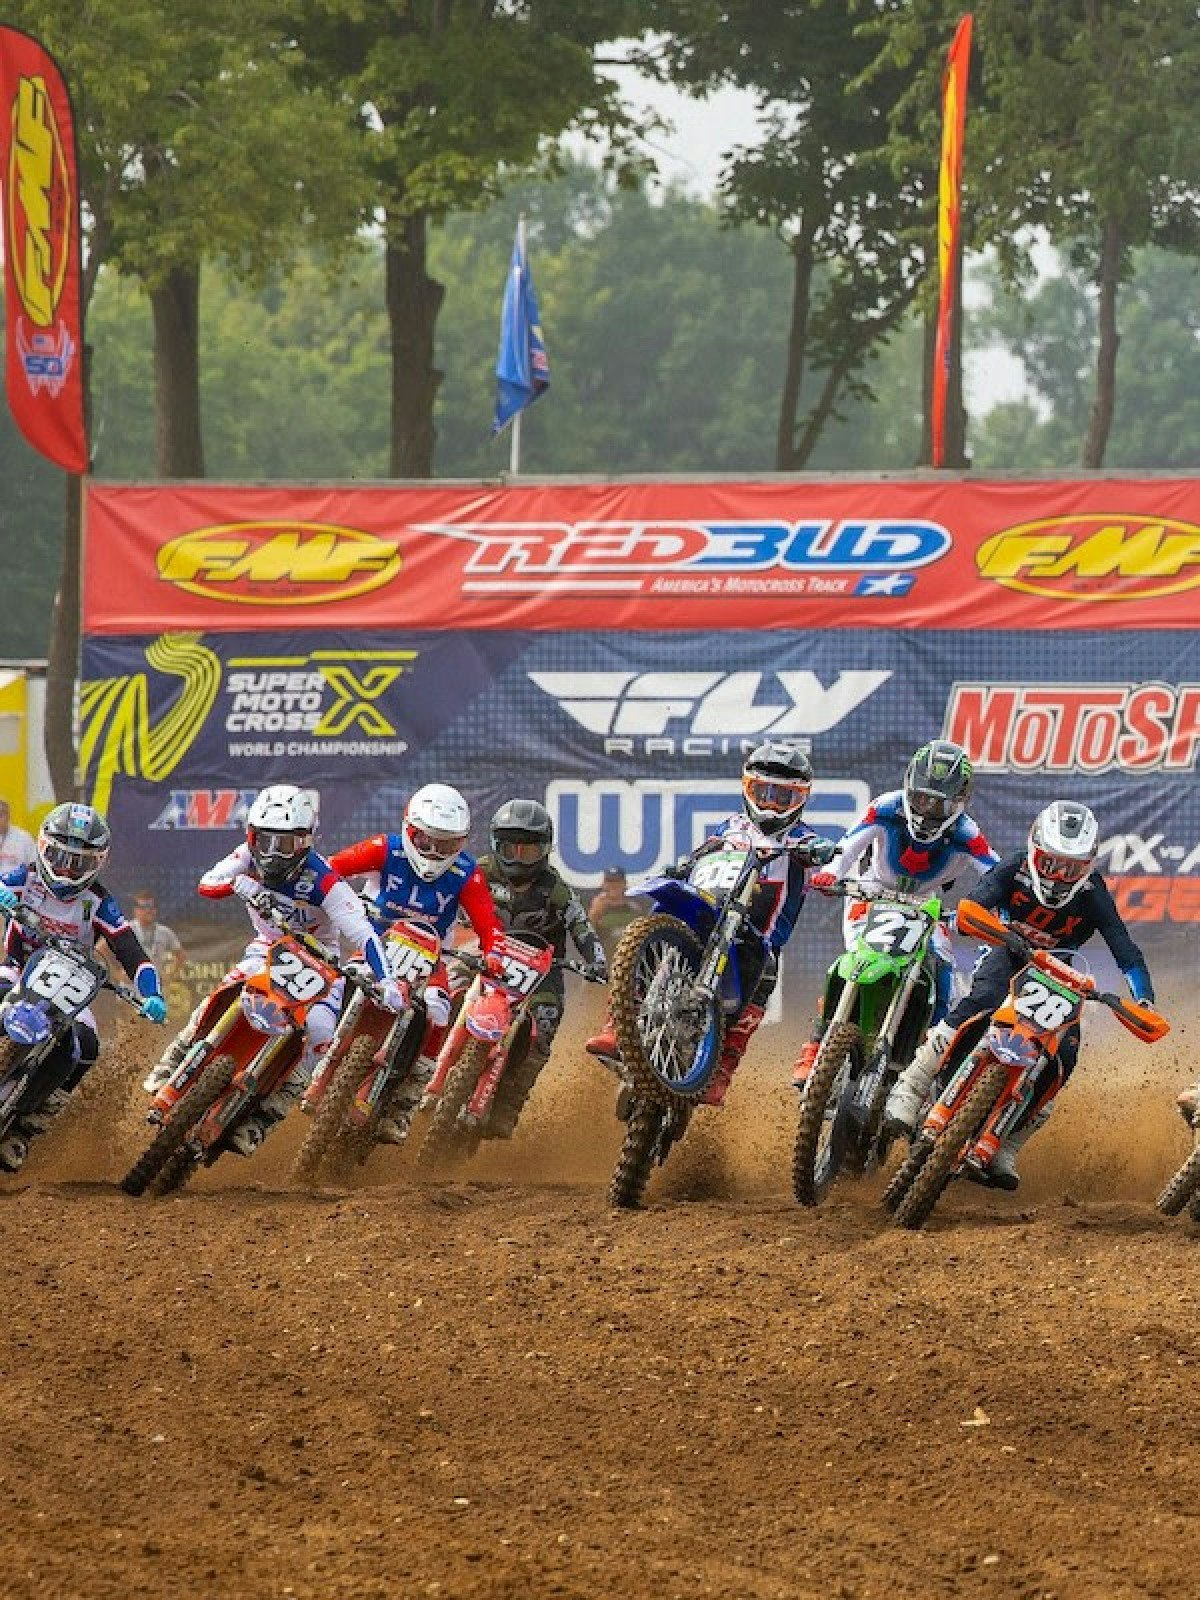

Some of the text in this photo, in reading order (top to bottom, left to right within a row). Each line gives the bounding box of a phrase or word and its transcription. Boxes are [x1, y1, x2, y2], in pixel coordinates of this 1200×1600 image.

[17, 77, 53, 326] FMF
[159, 532, 402, 582] FMF
[412, 519, 953, 574] REDBUD
[226, 672, 325, 692] SUPER
[232, 693, 323, 712] MOTO
[312, 666, 403, 737] X
[528, 670, 894, 735] FLY
[225, 712, 323, 732] CROSS
[228, 742, 409, 757] WORLD CHAMPIONSHIP
[865, 911, 927, 953] 21
[268, 950, 326, 1001] 29
[1014, 982, 1074, 1031] 28
